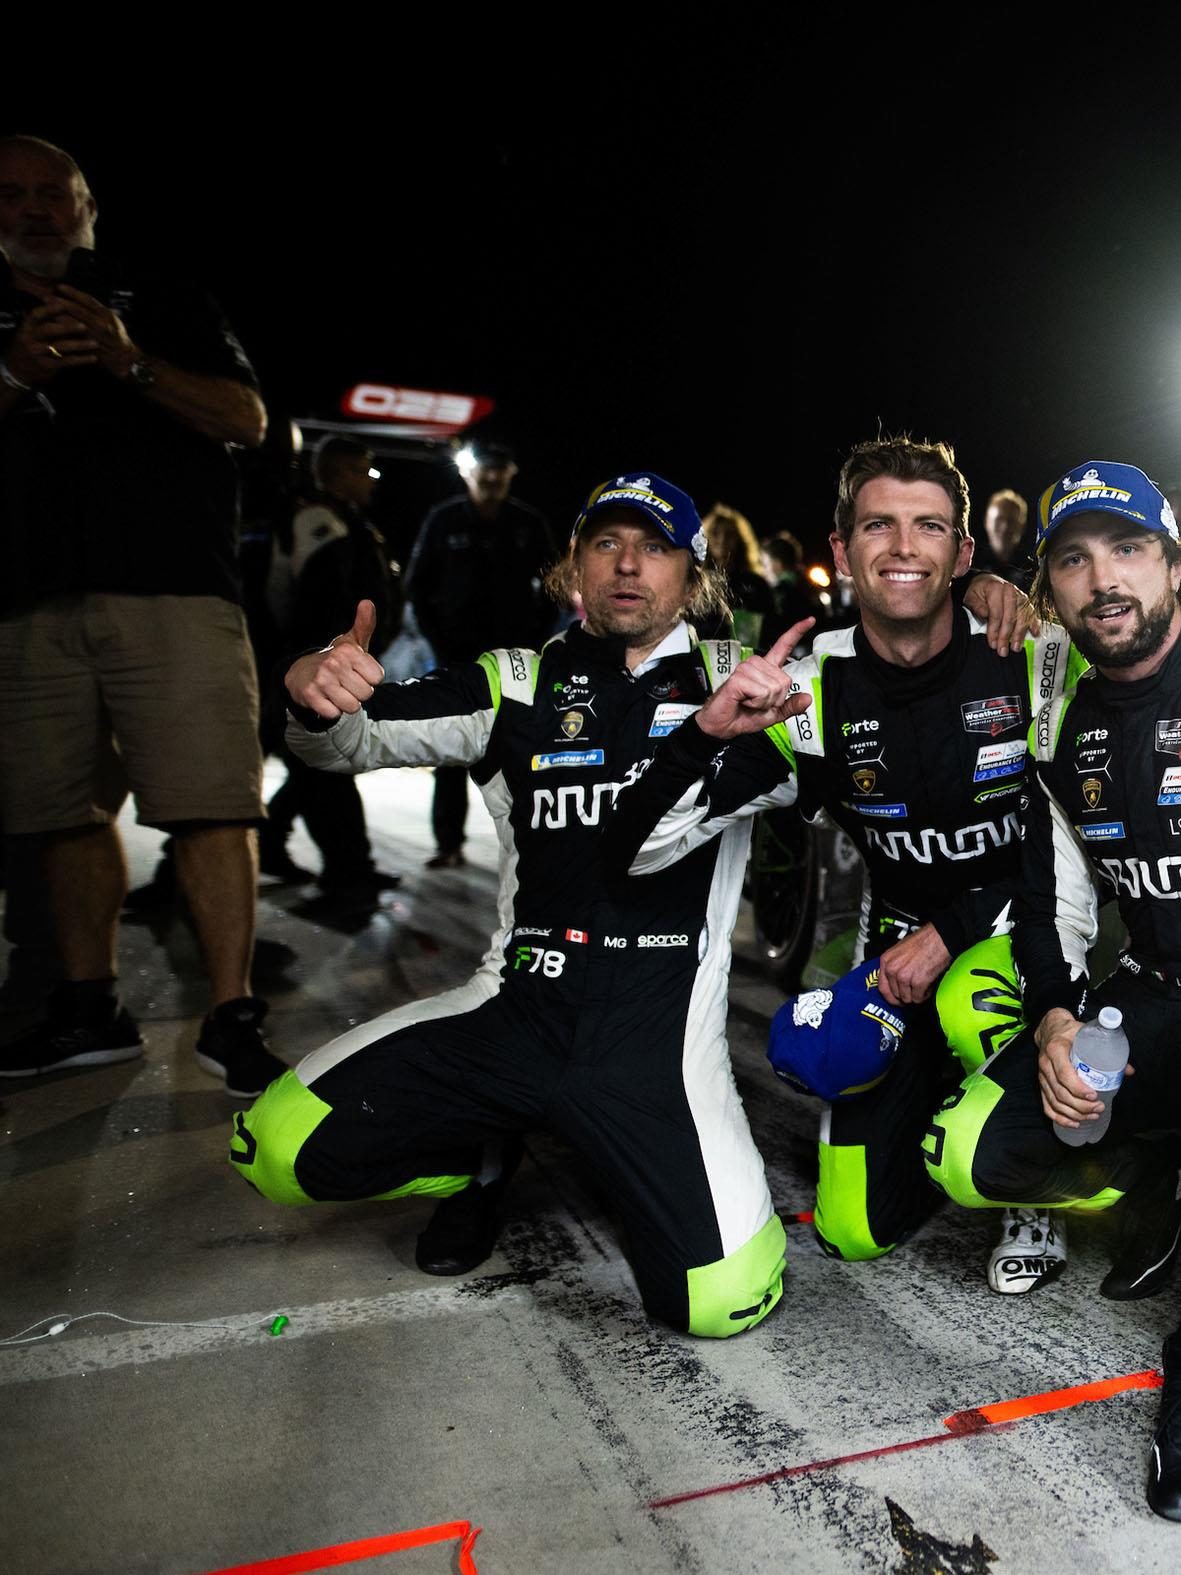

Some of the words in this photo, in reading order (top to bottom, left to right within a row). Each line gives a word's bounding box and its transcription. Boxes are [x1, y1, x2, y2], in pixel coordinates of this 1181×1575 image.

[597, 491, 673, 513] MICHELIN
[1051, 490, 1132, 520] MICHELIN
[1040, 642, 1057, 699] sparco
[552, 755, 598, 763] MICHELIN
[858, 806, 900, 815] MICHELIN
[1085, 828, 1119, 836] MICHELIN
[604, 936, 628, 949] MG
[514, 946, 567, 978] F78
[1002, 1259, 1057, 1275] OMP
